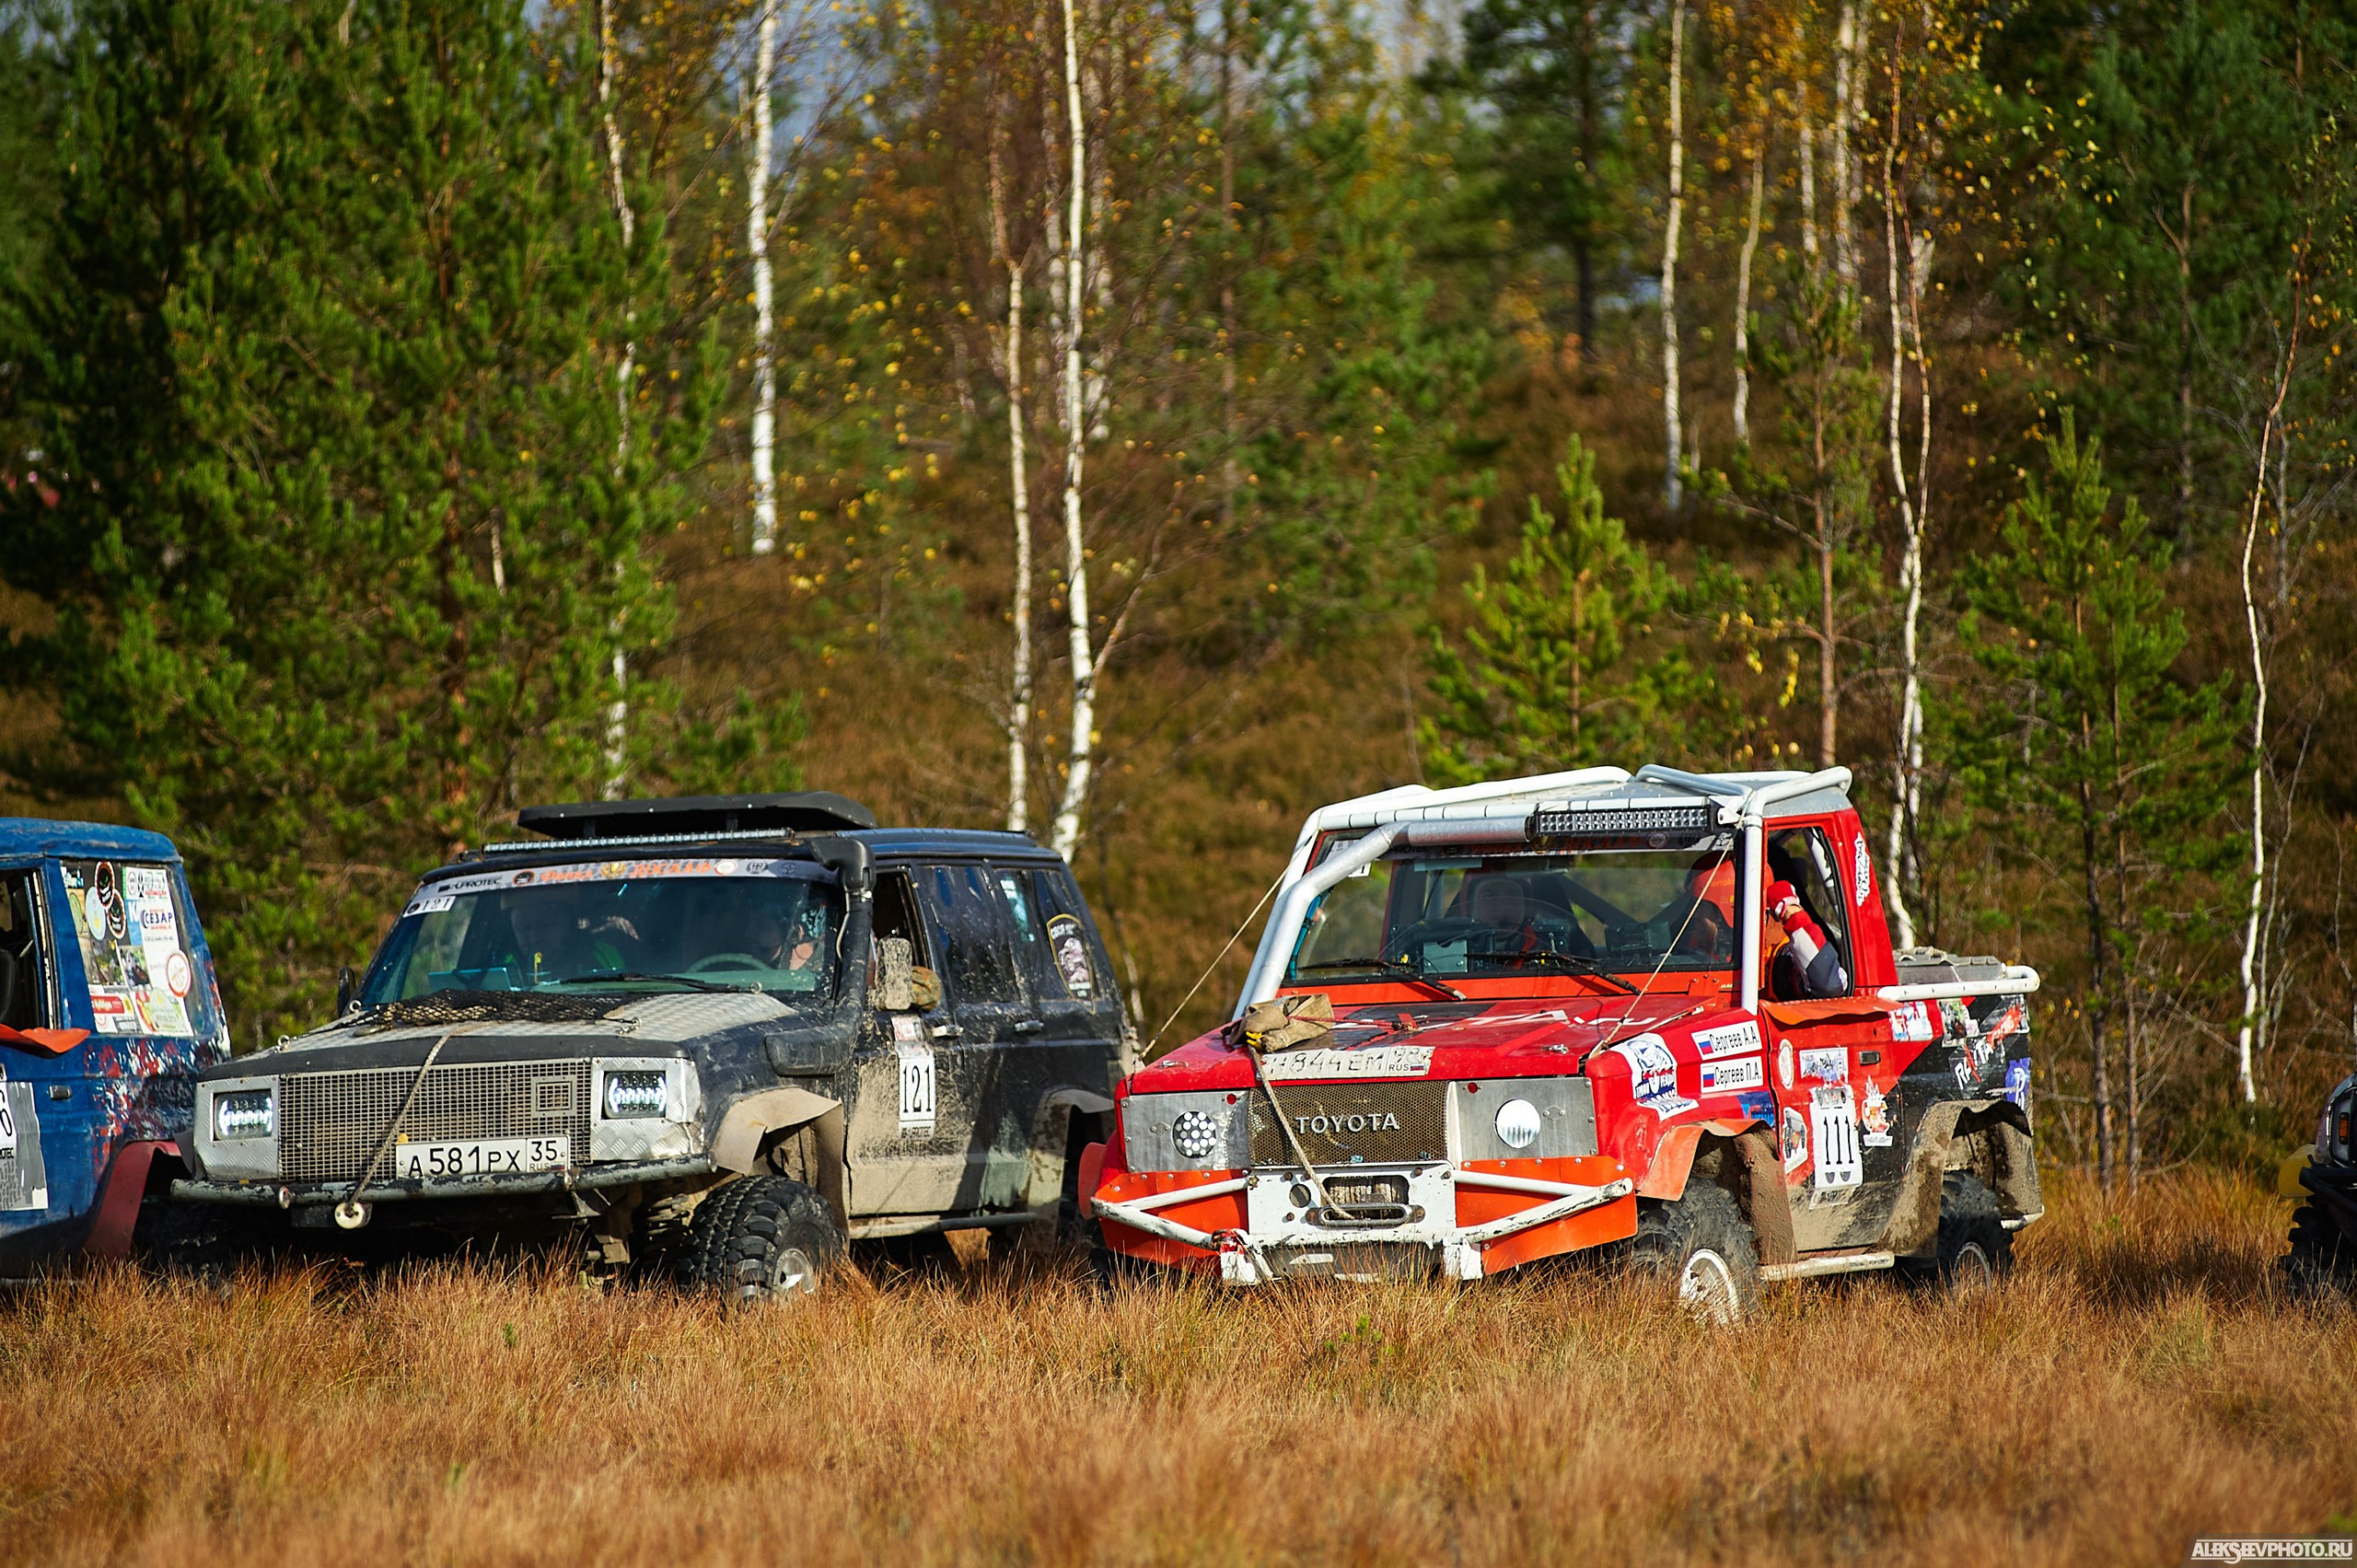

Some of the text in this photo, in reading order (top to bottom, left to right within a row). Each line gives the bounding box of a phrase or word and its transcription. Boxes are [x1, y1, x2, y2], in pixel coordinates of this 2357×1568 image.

[628, 861, 713, 878] ДОСААФ
[423, 899, 450, 912] 121
[1710, 1026, 1760, 1054] Сергеев А.А.
[1388, 1063, 1410, 1072] RUS
[1714, 1062, 1762, 1088] Сергеев П.А.
[902, 1065, 932, 1113] 121
[1295, 1112, 1400, 1134] TOYOTA
[530, 1140, 558, 1162] 35
[1823, 1115, 1854, 1165] 111
[529, 1162, 551, 1172] RUS
